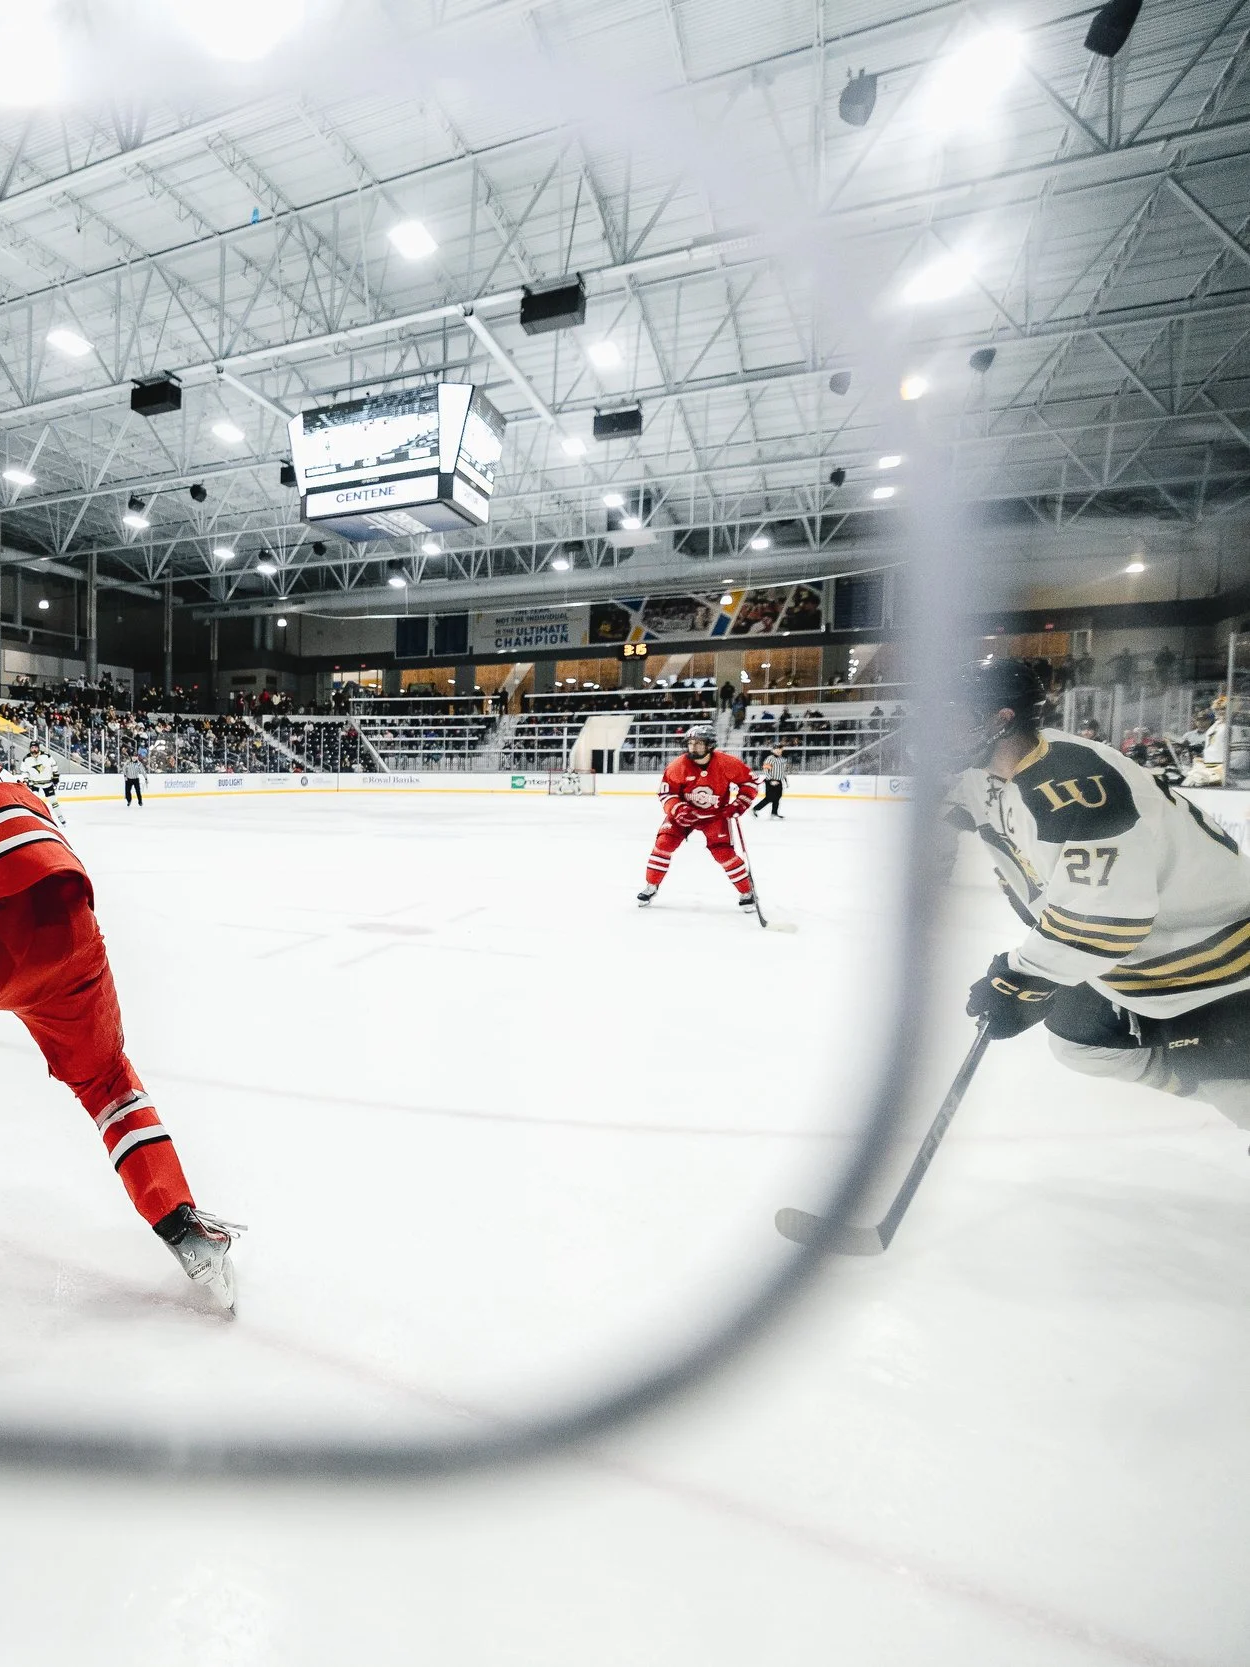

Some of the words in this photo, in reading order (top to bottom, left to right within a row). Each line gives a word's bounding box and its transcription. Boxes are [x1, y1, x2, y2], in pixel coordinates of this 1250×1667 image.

[336, 486, 396, 503] CENTENE
[526, 613, 568, 621] INDIVIDUAL
[516, 624, 568, 635] ULTIMATE
[494, 634, 568, 647] CHAMPION
[230, 778, 243, 786] LIGHT
[368, 776, 391, 785] Royal
[393, 776, 420, 784] Banks
[1034, 775, 1107, 812] LU
[1064, 847, 1119, 887] 27
[990, 977, 1051, 1002] CC
[1168, 1037, 1199, 1049] CCM
